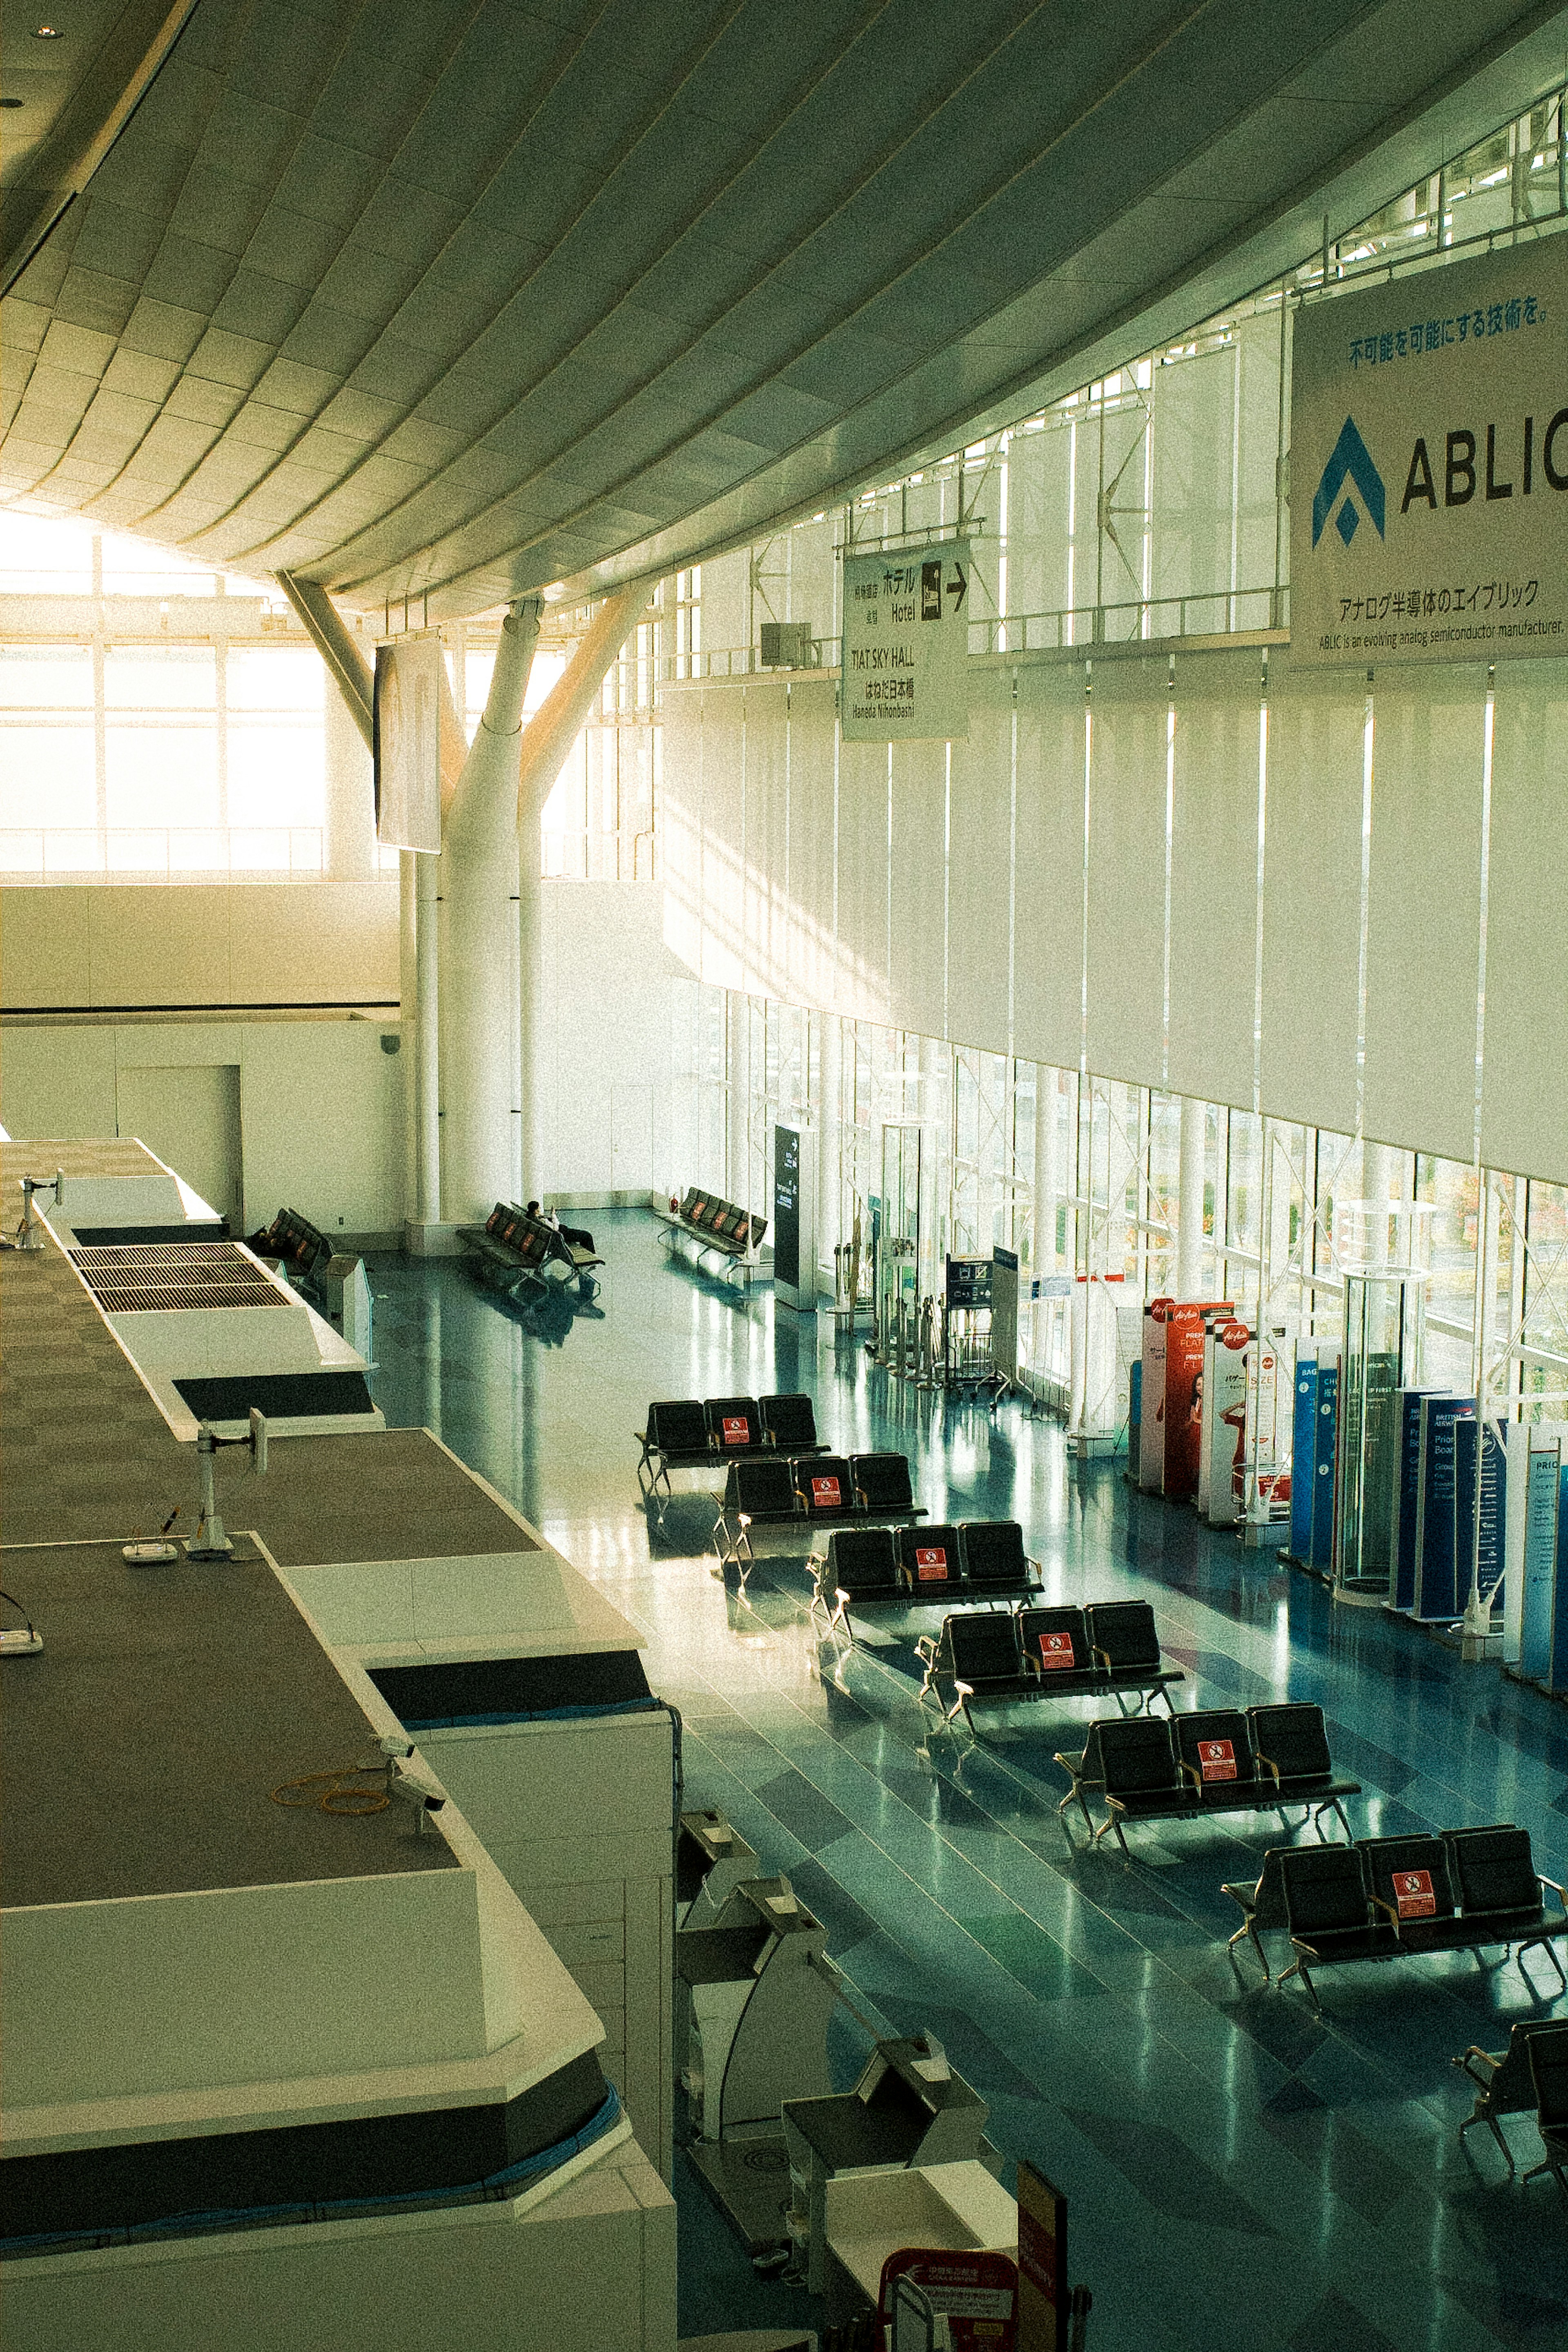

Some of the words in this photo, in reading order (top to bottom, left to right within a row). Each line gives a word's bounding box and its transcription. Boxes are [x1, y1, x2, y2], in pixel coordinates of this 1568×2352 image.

[1349, 295, 1546, 369] 不可能を可能にする技術を。
[883, 566, 915, 595] ホテル
[891, 598, 915, 623] Hotel
[1340, 580, 1539, 623] アナログ半導体のエイブリック
[1319, 633, 1341, 650] ABLIC
[1343, 633, 1350, 649] is
[1352, 635, 1361, 648] an
[1364, 631, 1397, 650] evolving
[1400, 628, 1428, 647] analog
[1430, 624, 1496, 643] semiconductor
[1499, 618, 1564, 637] manufacturer.
[872, 648, 889, 669] SKY
[891, 646, 914, 668] HALL
[866, 678, 914, 700] はねだ日本橋
[853, 703, 876, 719] Haneda
[878, 702, 915, 719] Nihonbashi
[1251, 1376, 1273, 1384] SZE
